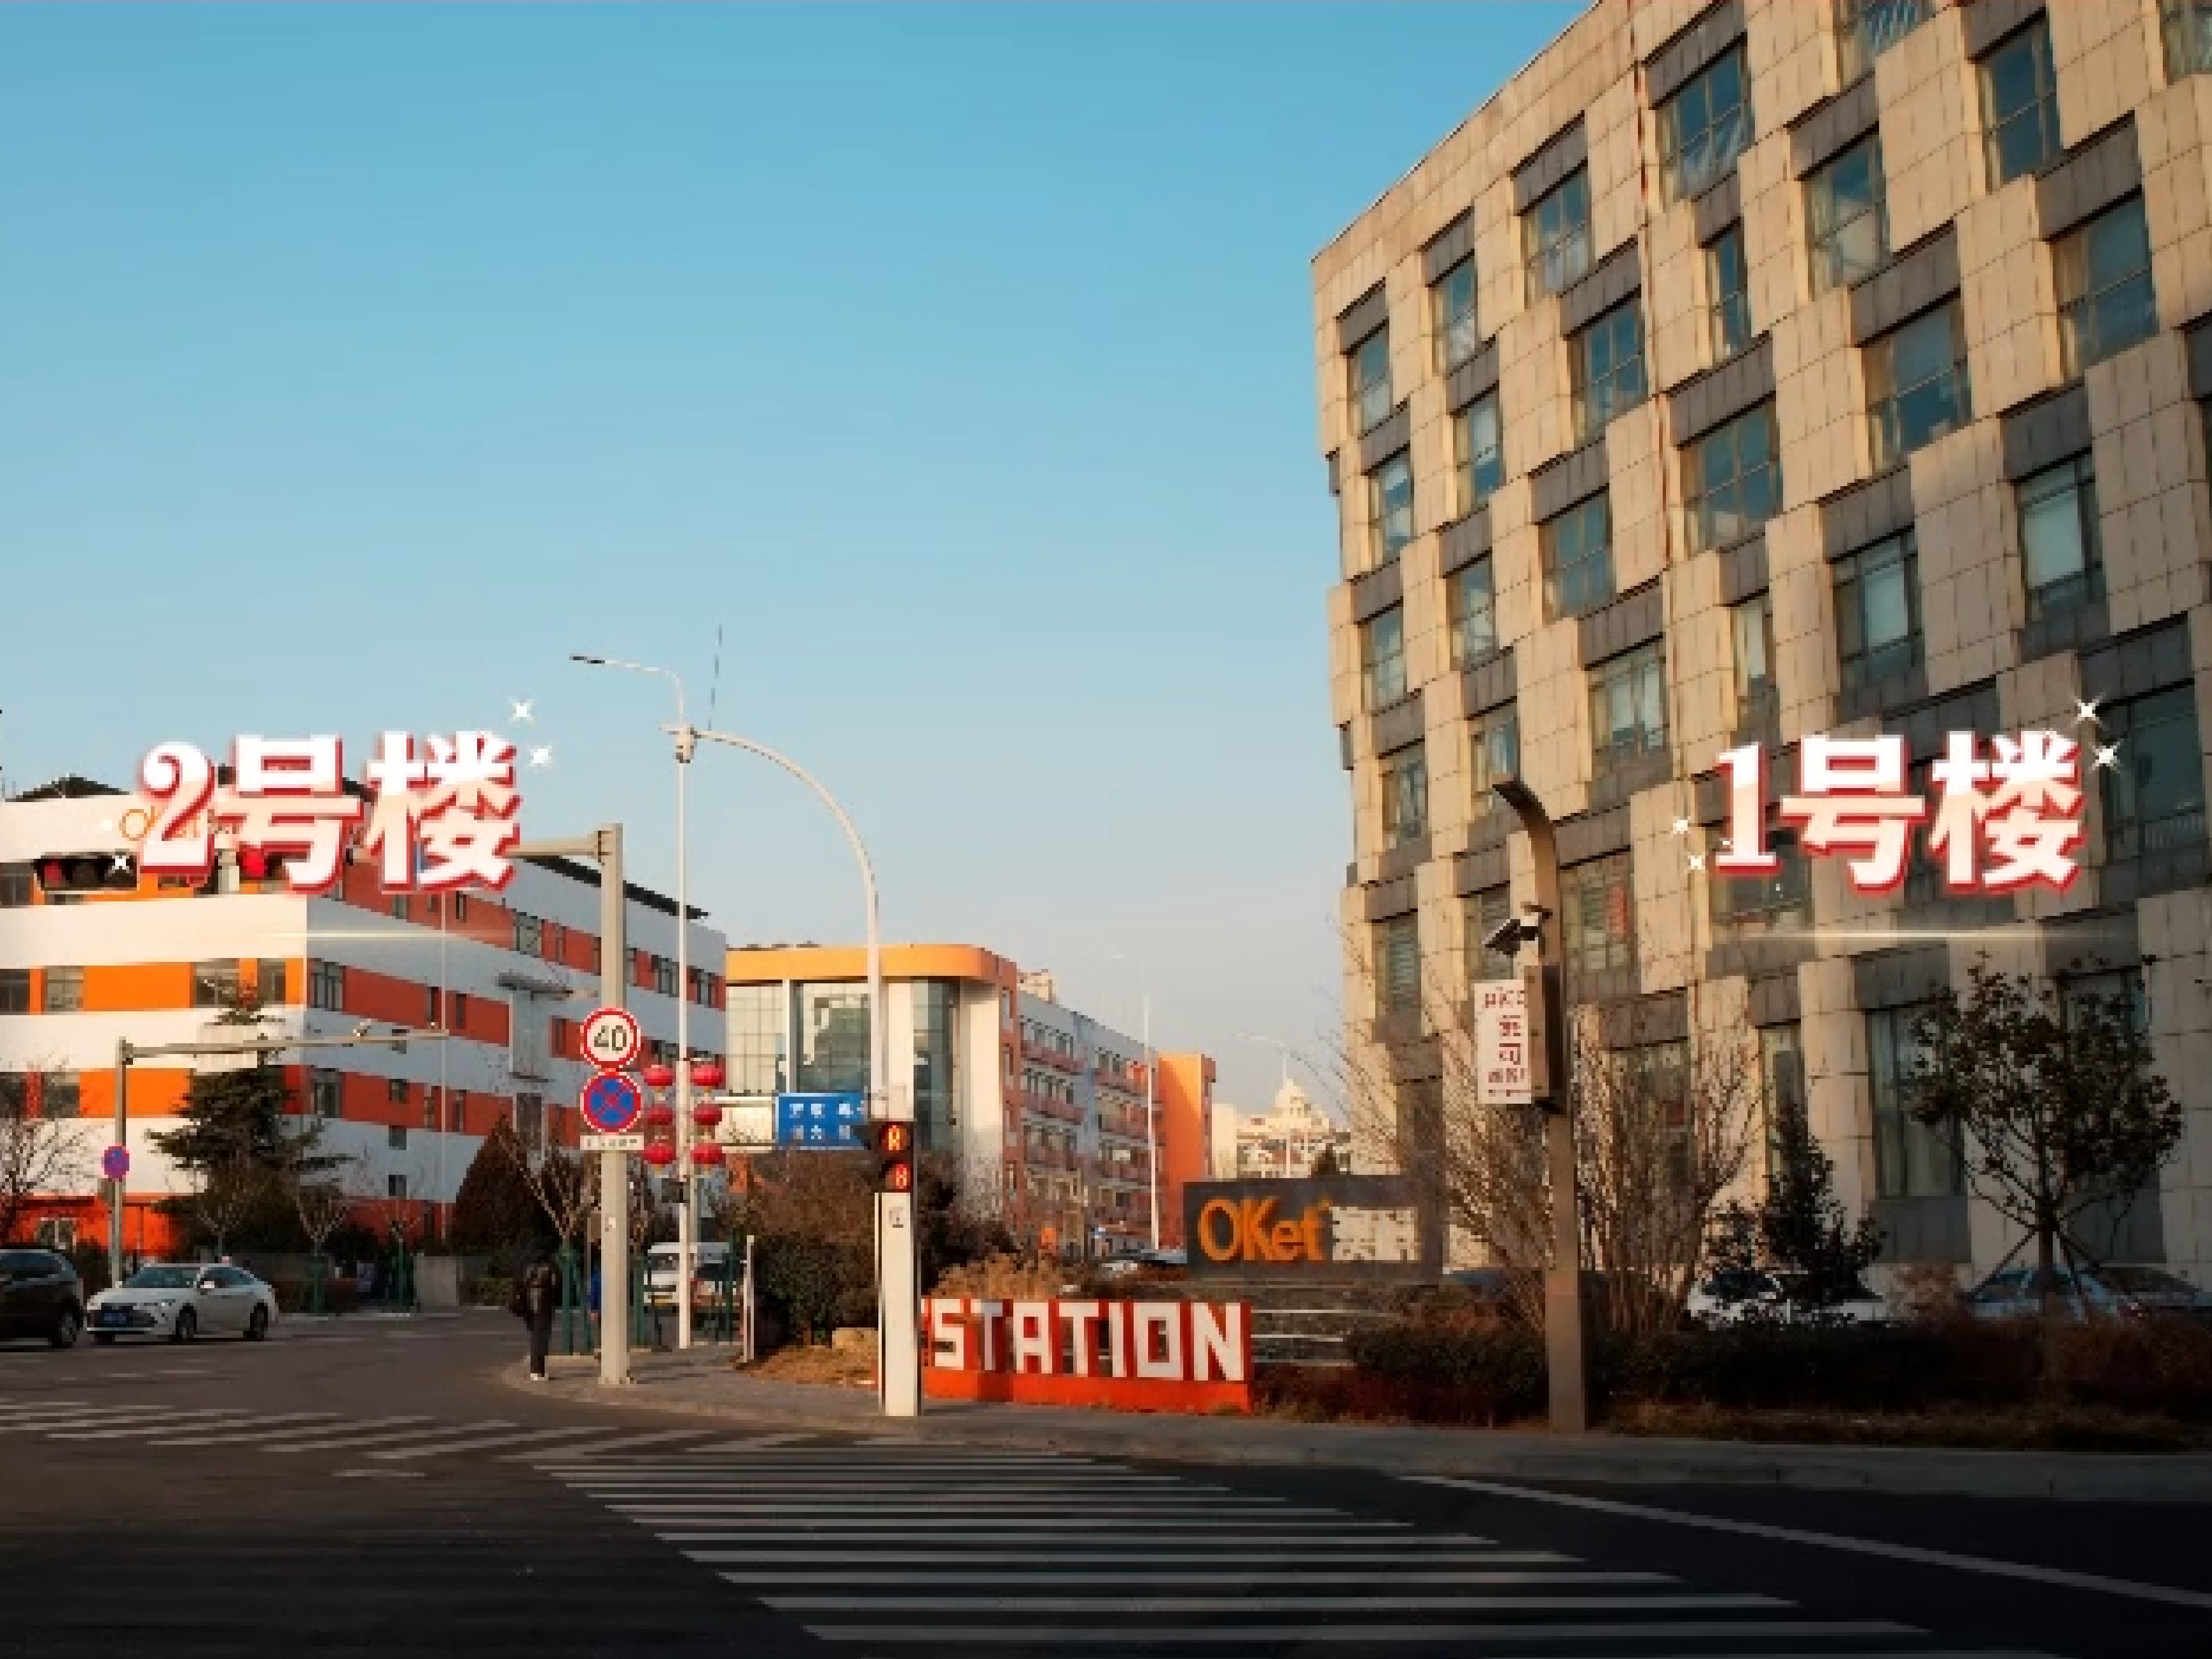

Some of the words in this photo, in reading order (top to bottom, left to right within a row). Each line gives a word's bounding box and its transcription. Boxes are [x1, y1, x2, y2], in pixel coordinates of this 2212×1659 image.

[593, 1025, 627, 1051] 40
[1197, 1195, 1325, 1261] OKet
[932, 1298, 1246, 1380] STATION
